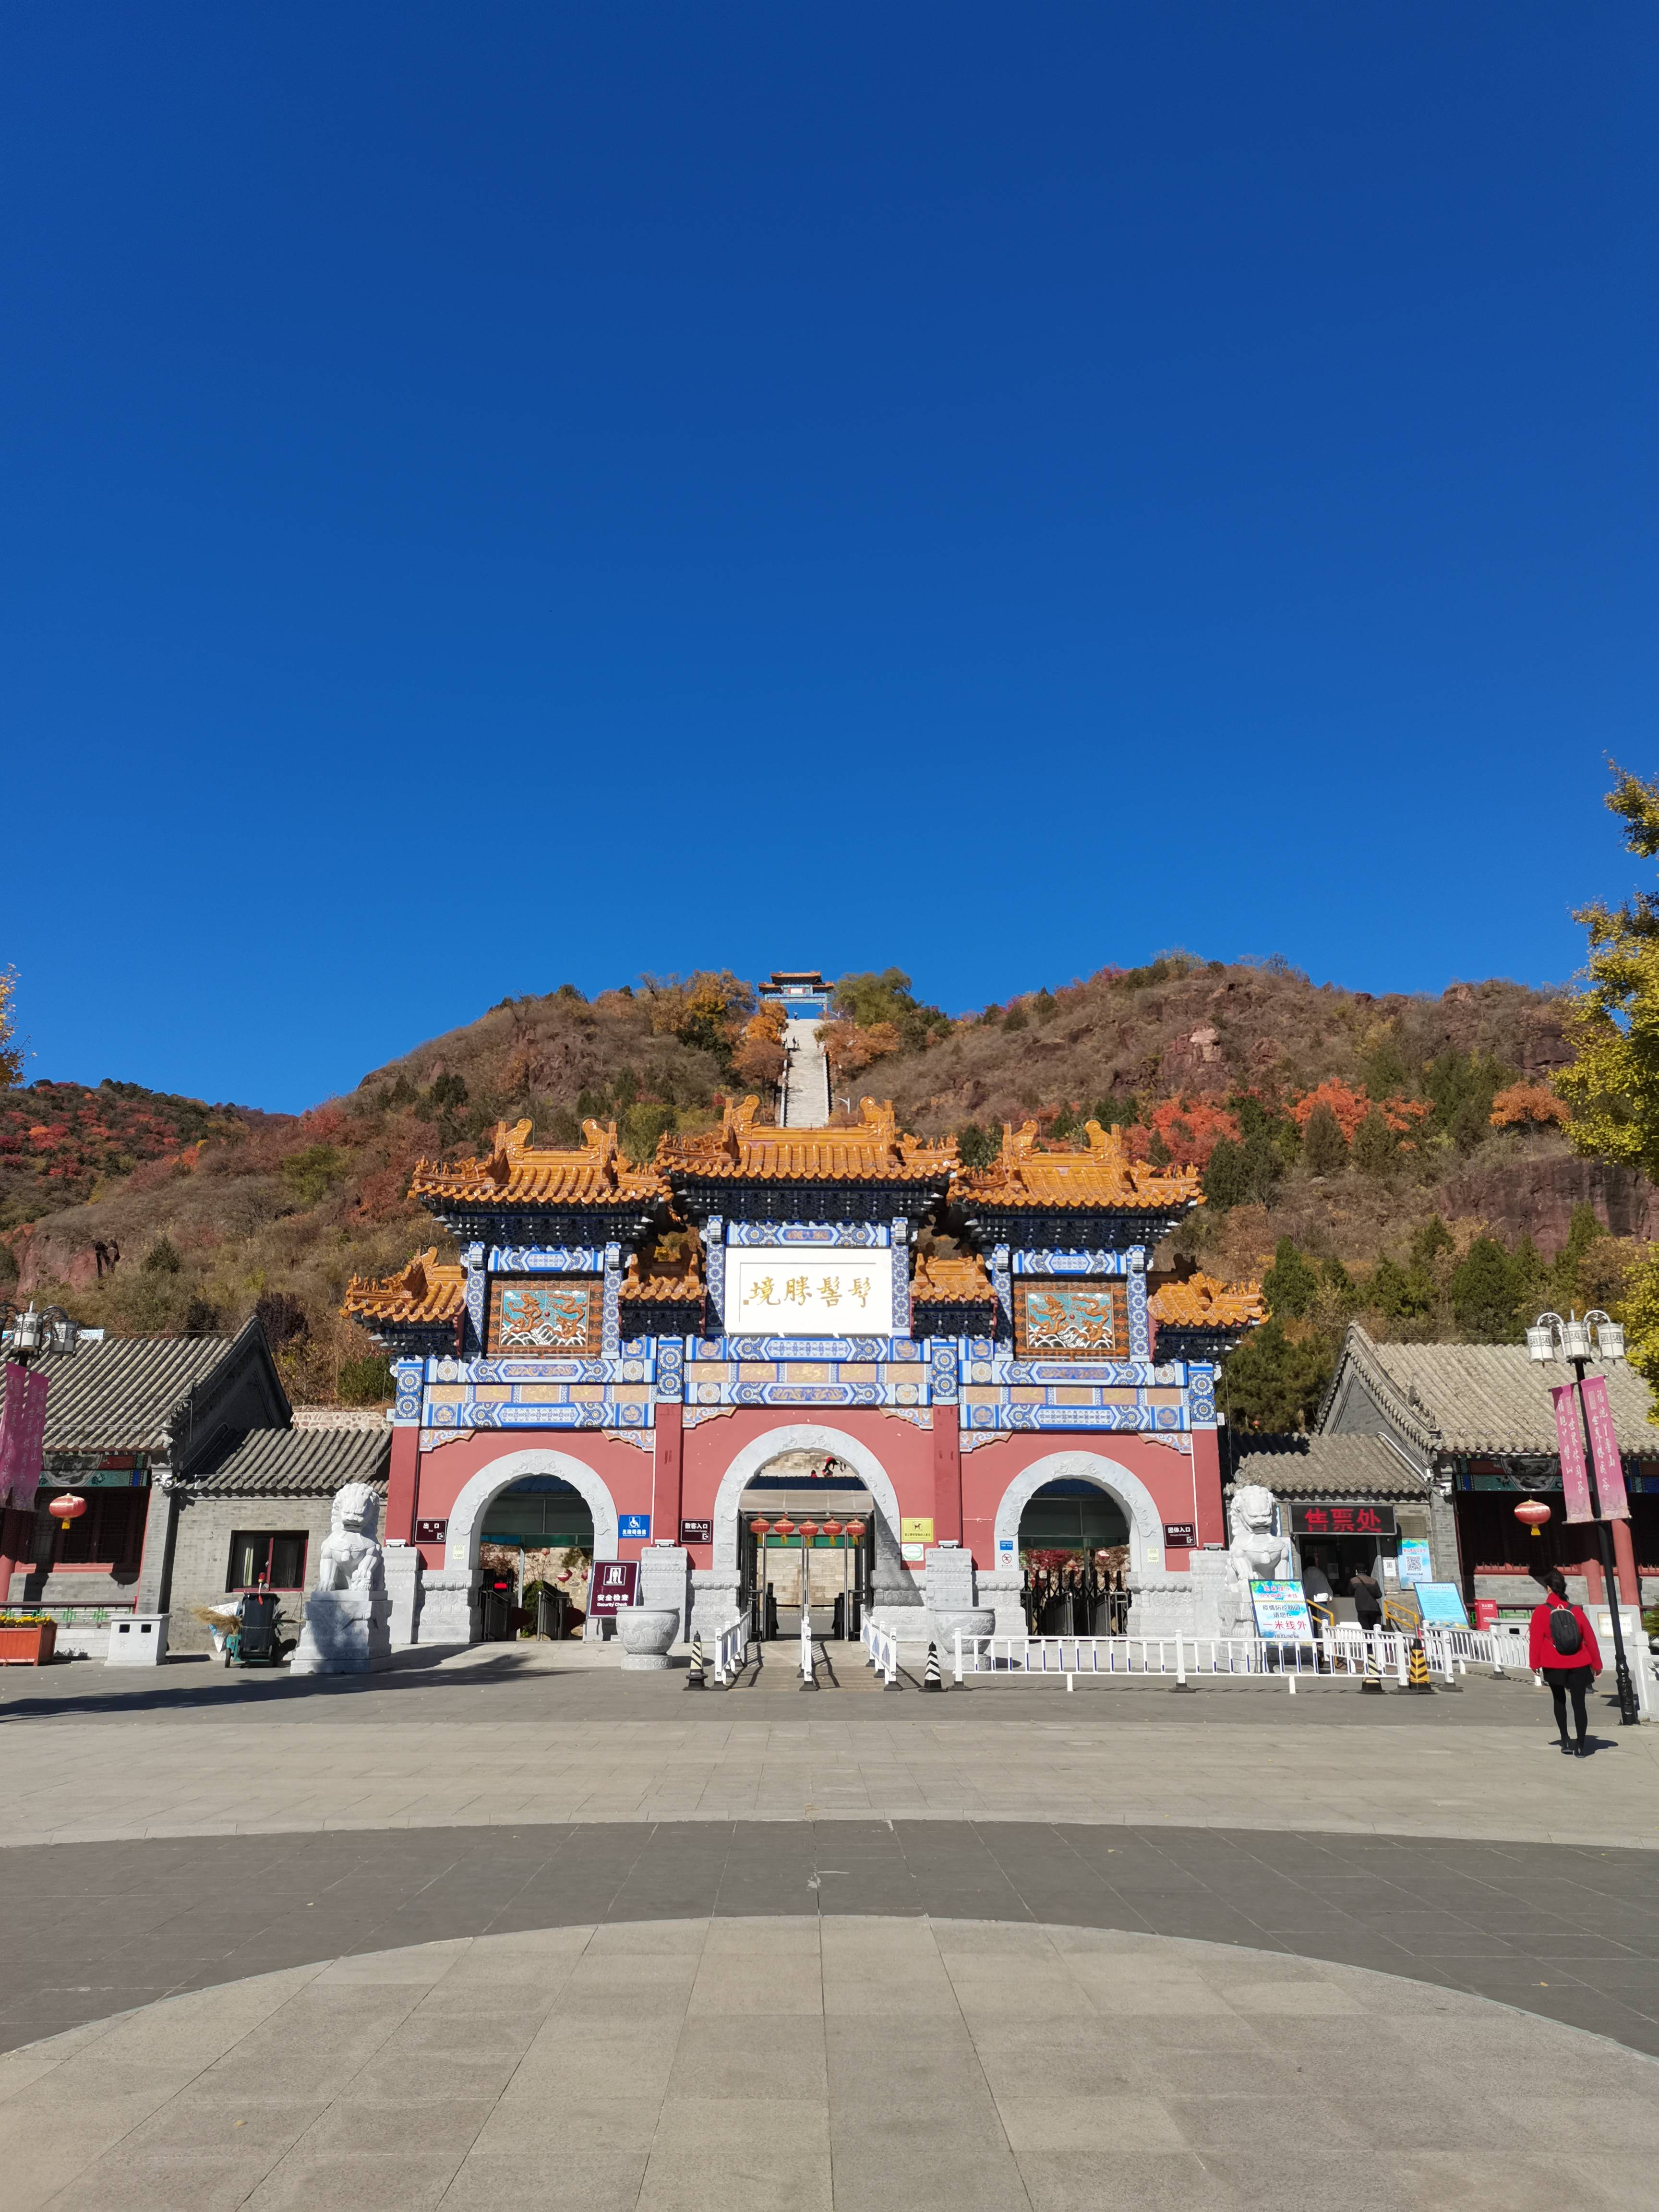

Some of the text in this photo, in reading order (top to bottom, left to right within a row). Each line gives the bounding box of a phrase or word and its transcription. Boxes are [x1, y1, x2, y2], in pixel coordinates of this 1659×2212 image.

[1304, 1507, 1382, 1533] 售票处
[1263, 1620, 1307, 1630] 一米线外
